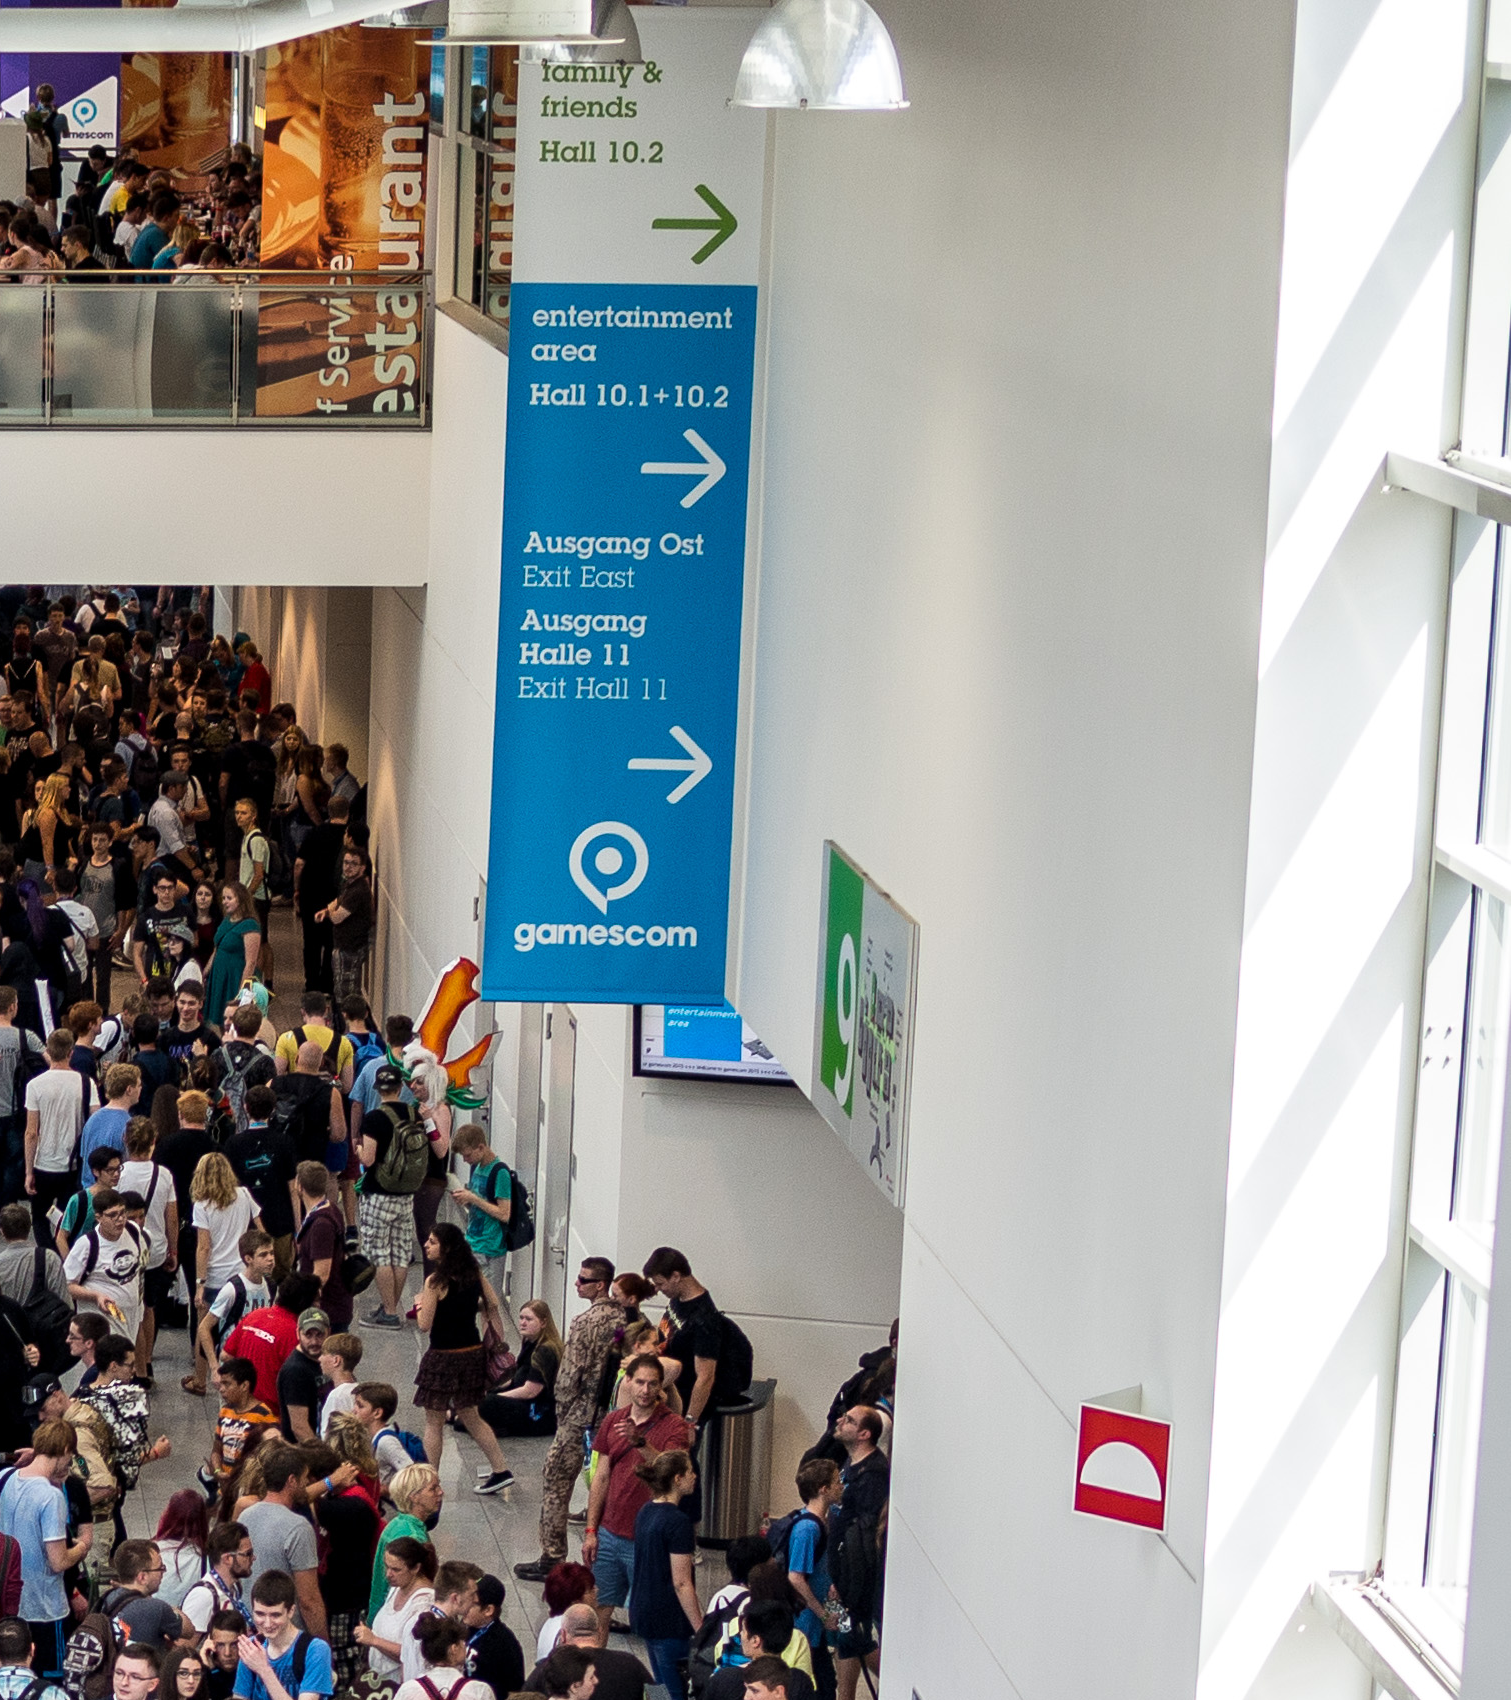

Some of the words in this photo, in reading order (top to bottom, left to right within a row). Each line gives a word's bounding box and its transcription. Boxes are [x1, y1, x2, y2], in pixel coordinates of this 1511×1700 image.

[541, 61, 634, 88] family
[643, 61, 663, 84] &
[540, 96, 638, 119] friends
[538, 140, 597, 163] Hall
[608, 141, 664, 164] 10.2
[531, 305, 733, 330] entertainment
[530, 341, 597, 362] area
[529, 383, 586, 407] Hall
[596, 384, 729, 408] 10.1+10.2
[523, 531, 651, 560] Ausgang
[658, 532, 704, 556] Ost
[522, 565, 572, 588] Exit
[579, 566, 636, 589] East
[520, 609, 648, 637] Ausgang
[518, 643, 592, 666] Halle
[602, 644, 630, 667] 11
[517, 676, 567, 699] Exit
[574, 677, 629, 700] Hall
[641, 679, 668, 701] 11
[513, 921, 698, 952] gamescom
[667, 1007, 739, 1019] entertainment
[667, 1019, 690, 1028] area
[834, 932, 857, 1107] 9
